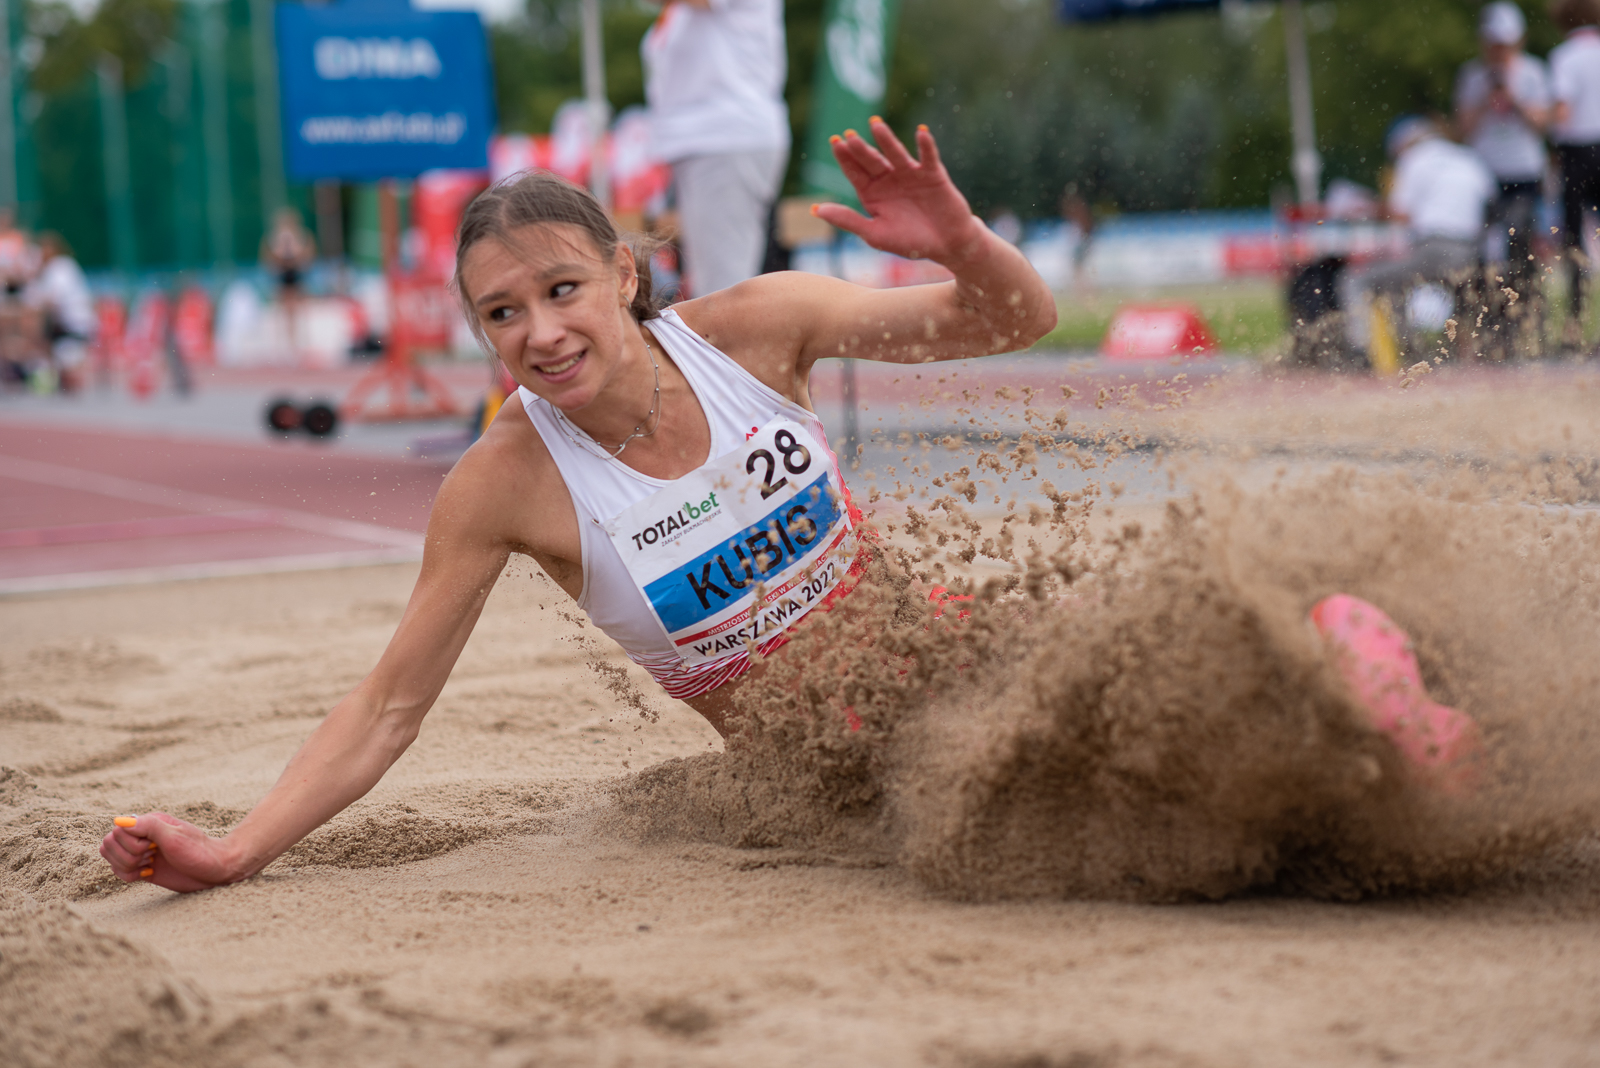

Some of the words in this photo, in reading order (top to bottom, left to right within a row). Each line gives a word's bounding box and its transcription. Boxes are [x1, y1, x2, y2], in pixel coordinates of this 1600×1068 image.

[746, 429, 811, 500] 28
[632, 492, 719, 551] TOTALbet
[686, 505, 817, 610] KUBIS
[693, 598, 802, 656] WARSZAWA
[802, 562, 838, 602] 2022
[708, 606, 756, 636] MISTRZOSTW
